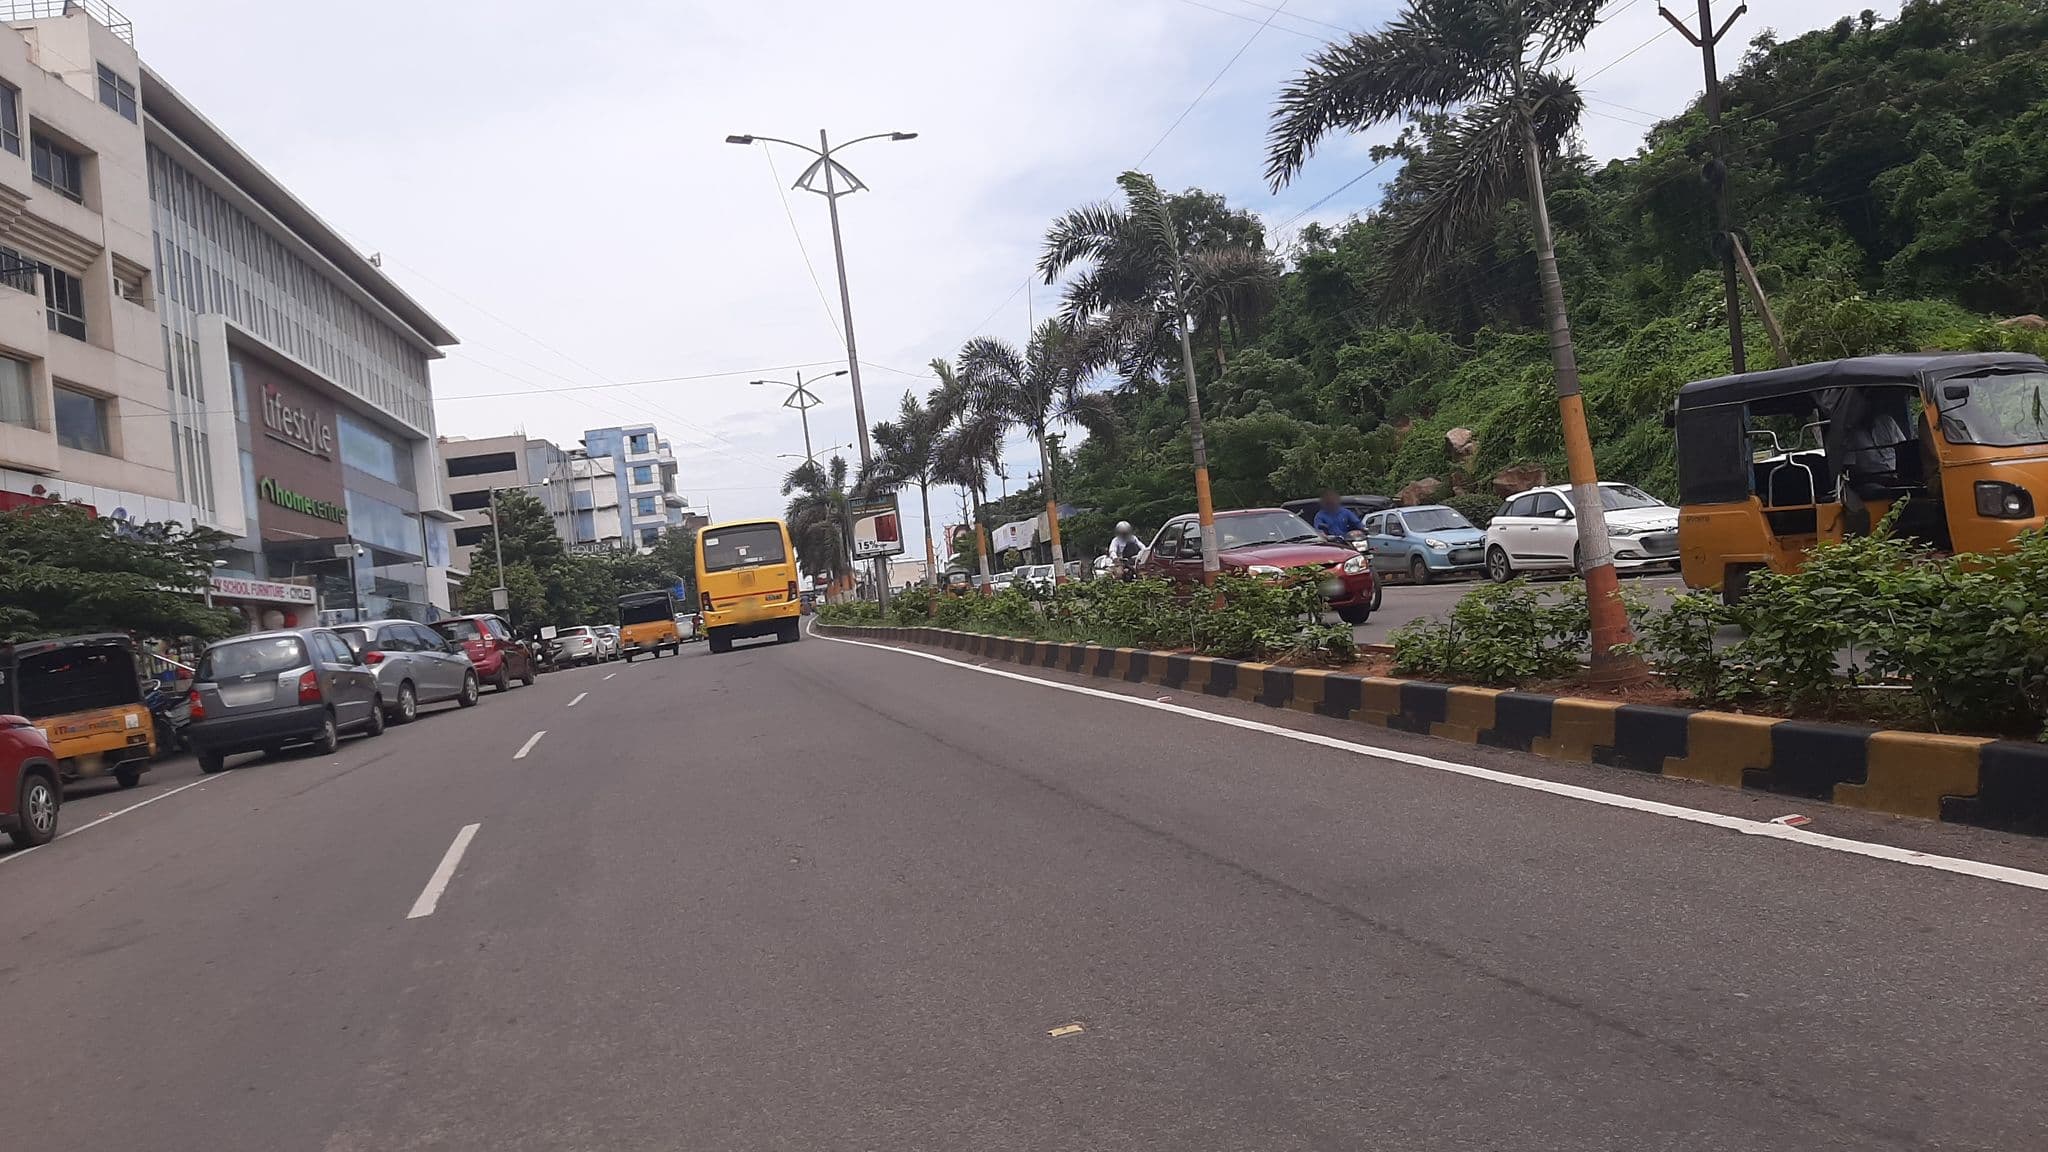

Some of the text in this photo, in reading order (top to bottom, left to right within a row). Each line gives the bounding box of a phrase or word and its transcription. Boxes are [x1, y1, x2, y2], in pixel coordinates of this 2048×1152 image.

[261, 383, 332, 455] lifestyle
[223, 580, 250, 596] SCHOOL
[251, 582, 285, 599] FURNITURE
